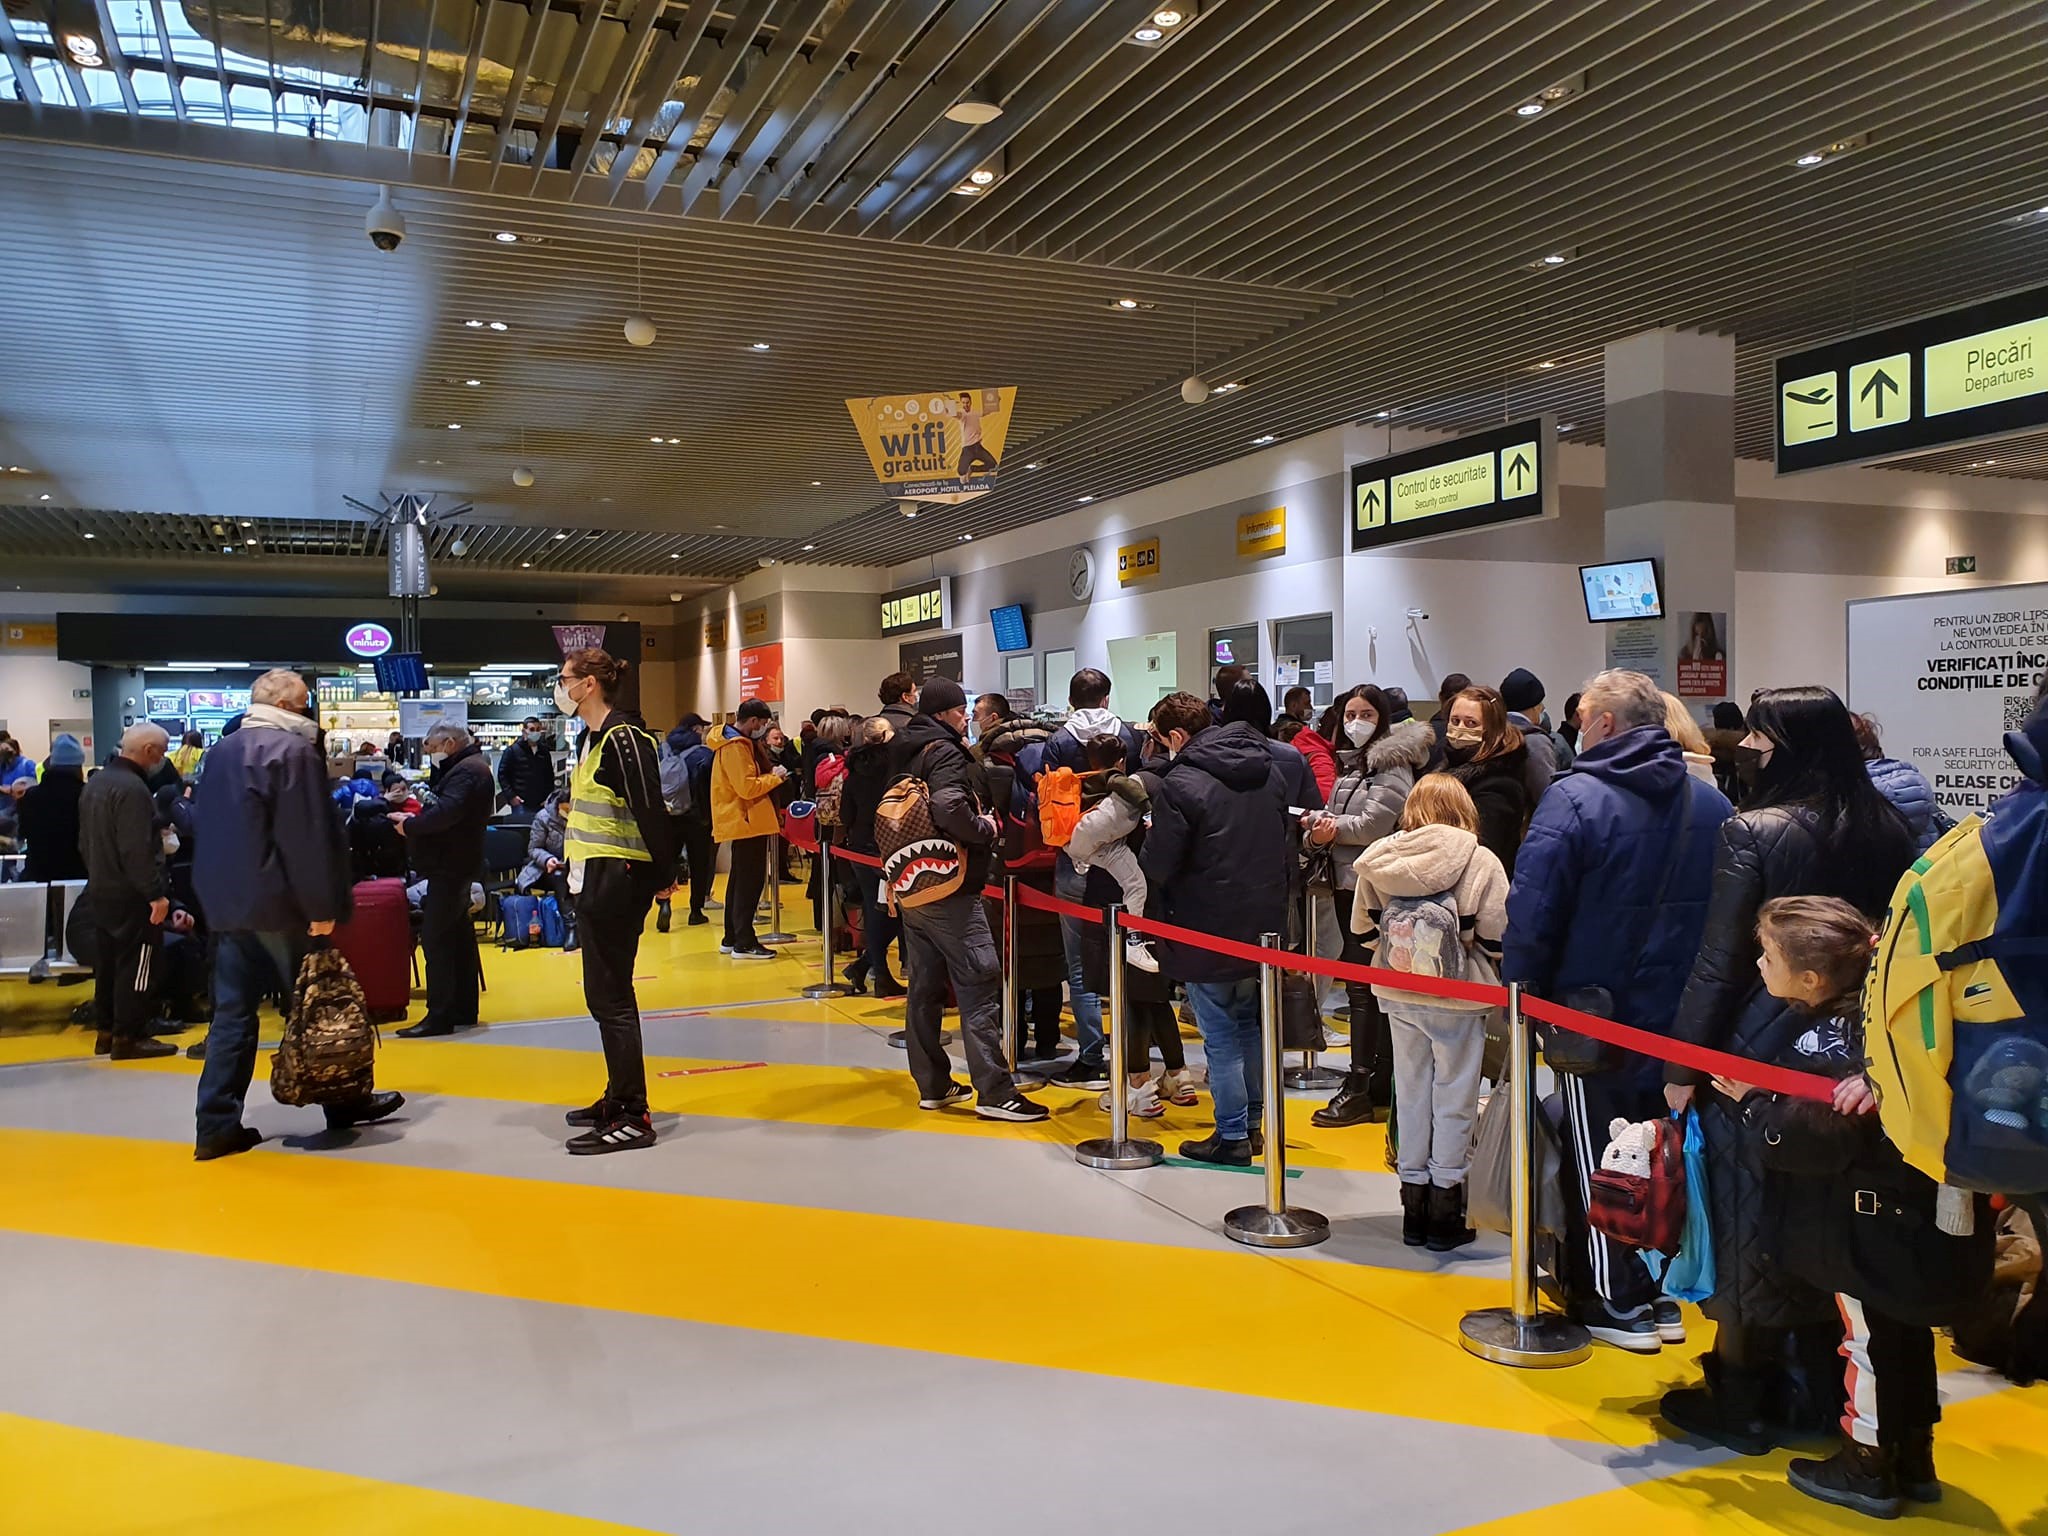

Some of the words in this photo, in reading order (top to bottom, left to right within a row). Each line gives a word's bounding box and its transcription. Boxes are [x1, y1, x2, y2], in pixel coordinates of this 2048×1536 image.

[1967, 336, 2032, 373] Plecări
[1965, 367, 2034, 392] Departures
[880, 421, 946, 457] wifi
[1397, 477, 1427, 498] Control
[1429, 475, 1441, 490] de
[1443, 465, 1487, 487] securitate
[1414, 495, 1438, 510] Security
[1439, 491, 1458, 505] control
[394, 532, 402, 552] CAR
[394, 557, 402, 565] A
[417, 556, 425, 564] A
[394, 566, 402, 591] RENT
[417, 566, 425, 591] RENT
[1934, 615, 1973, 627] PENTRU
[1975, 614, 1991, 625] UN
[1992, 611, 2021, 623] ZBOR
[362, 629, 373, 640] 1
[1953, 628, 1967, 638] NE
[1969, 626, 1991, 637] VOM
[1993, 623, 2028, 635] VEDEA
[2032, 621, 2045, 633] ÎN
[353, 638, 385, 647] minute
[563, 634, 587, 647] wifi
[1941, 641, 1954, 651] LA
[1955, 637, 2017, 650] CONTROLUL
[2019, 636, 2034, 646] DE
[1927, 655, 2012, 673] VERIFICAȚI
[1917, 674, 2003, 692] CONDIȚIILE
[2007, 673, 2029, 687] DE
[542, 697, 554, 705] TO
[1912, 747, 1931, 757] FOR
[1933, 747, 1941, 757] A
[1942, 747, 1967, 757] SAFE
[1944, 759, 1996, 770] SECURITY
[1935, 774, 1997, 789] PLEASE
[1933, 792, 1985, 806] RAVEL
